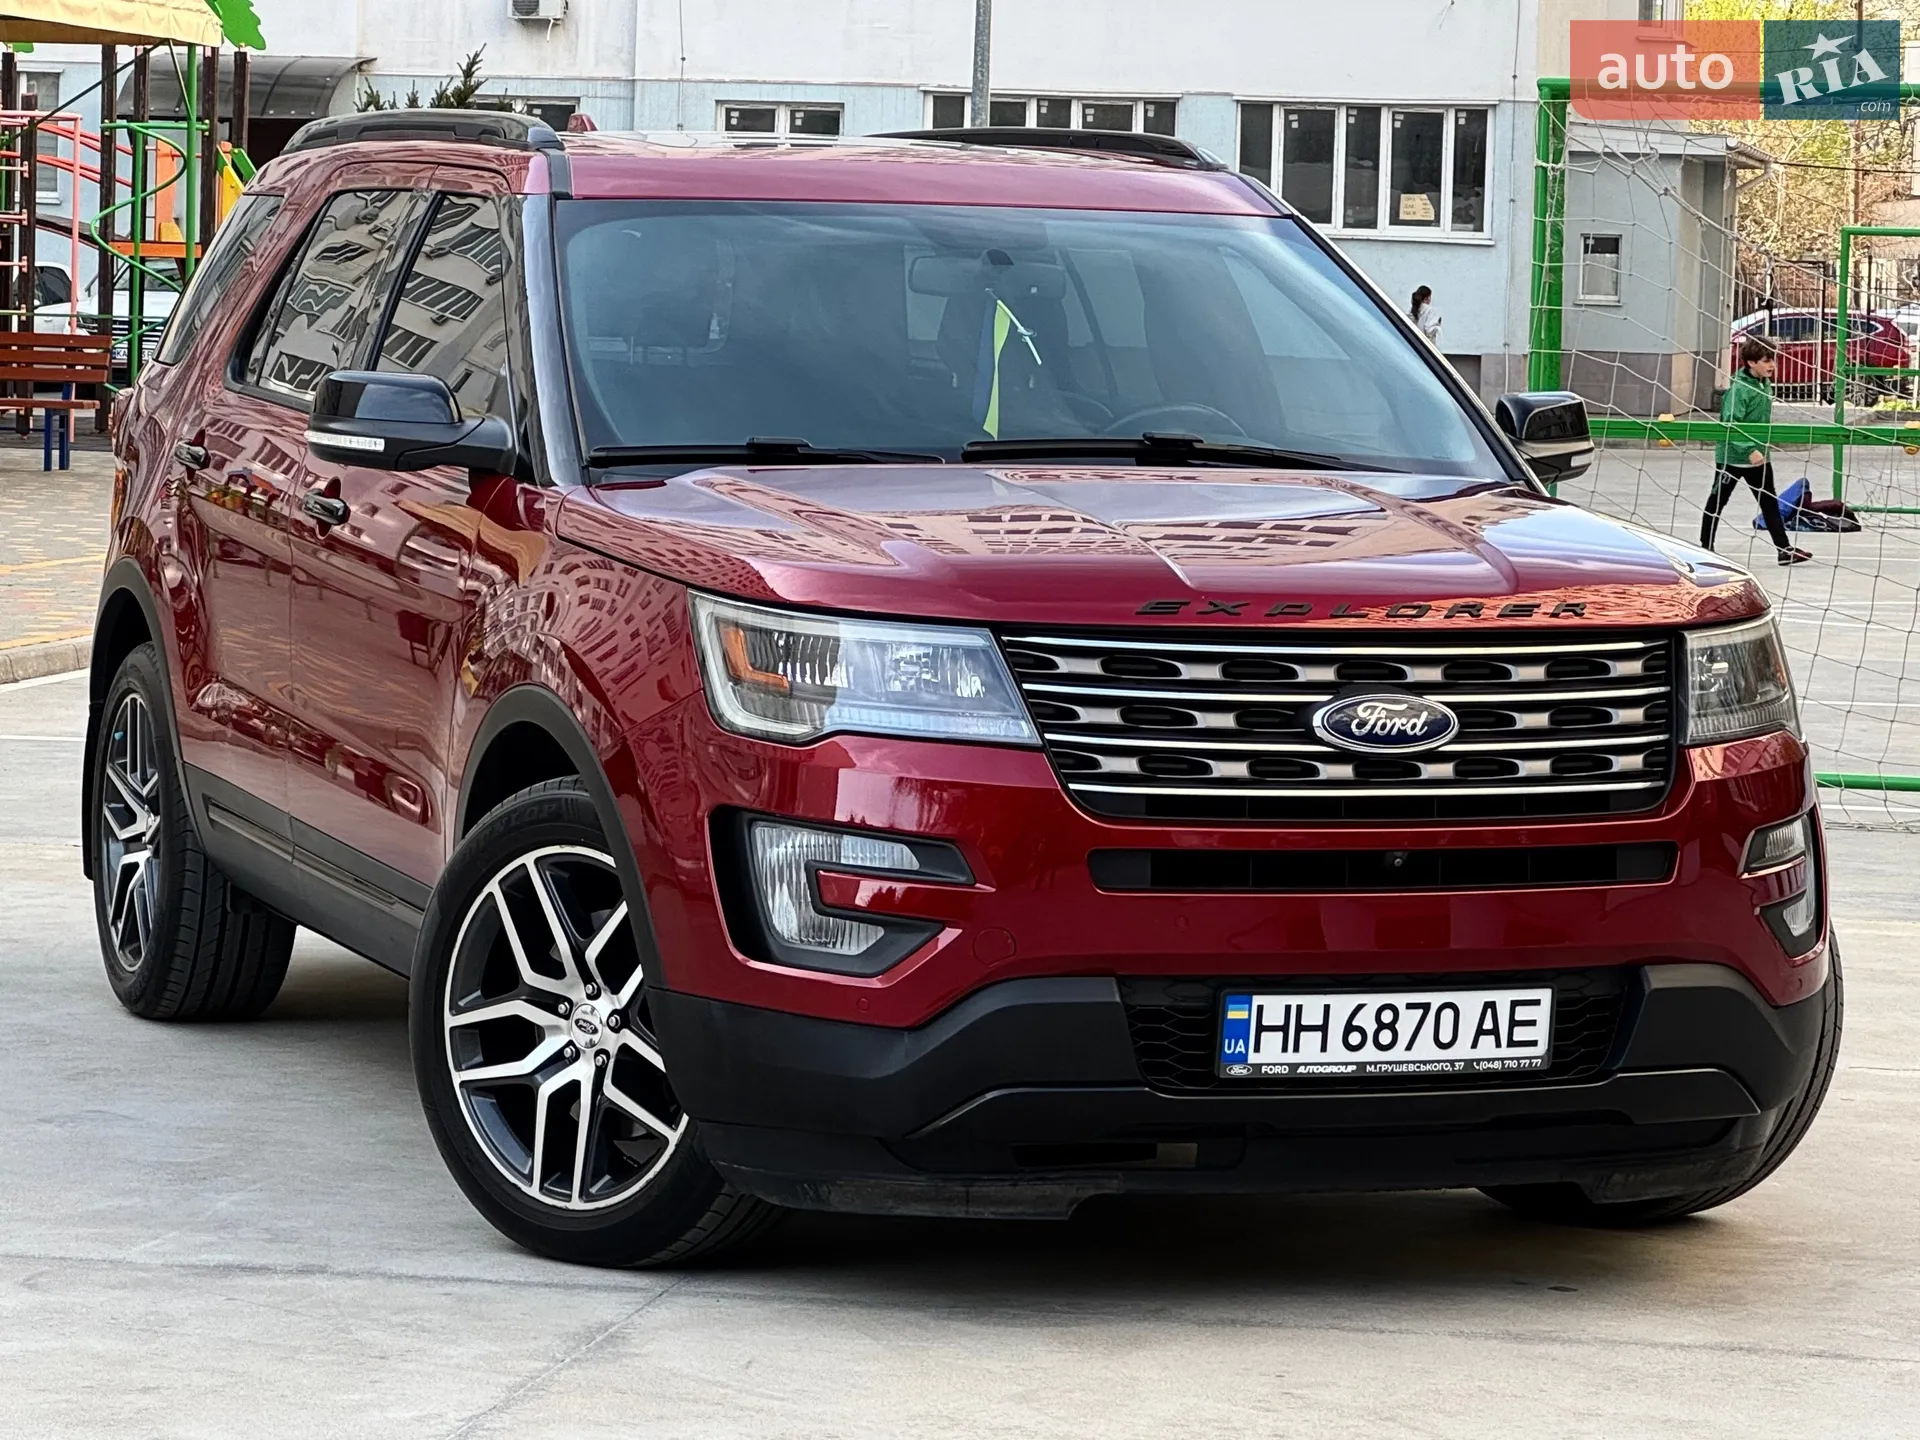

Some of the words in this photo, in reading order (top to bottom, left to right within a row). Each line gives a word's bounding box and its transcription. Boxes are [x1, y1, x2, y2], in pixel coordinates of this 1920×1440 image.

[1135, 600, 1586, 618] EXPLORER
[1351, 702, 1428, 736] Ford
[1253, 1003, 1330, 1053] HH
[1342, 1001, 1460, 1052] 6870
[1470, 999, 1541, 1049] AE
[1224, 1038, 1246, 1054] UA
[1261, 1064, 1289, 1074] FORD
[1297, 1064, 1357, 1073] AUTOGROUP
[1454, 1062, 1464, 1070] 37
[1479, 1060, 1501, 1070] (048)
[1503, 1059, 1517, 1068] 710
[1519, 1059, 1529, 1067] 77
[1531, 1059, 1541, 1067] 77
